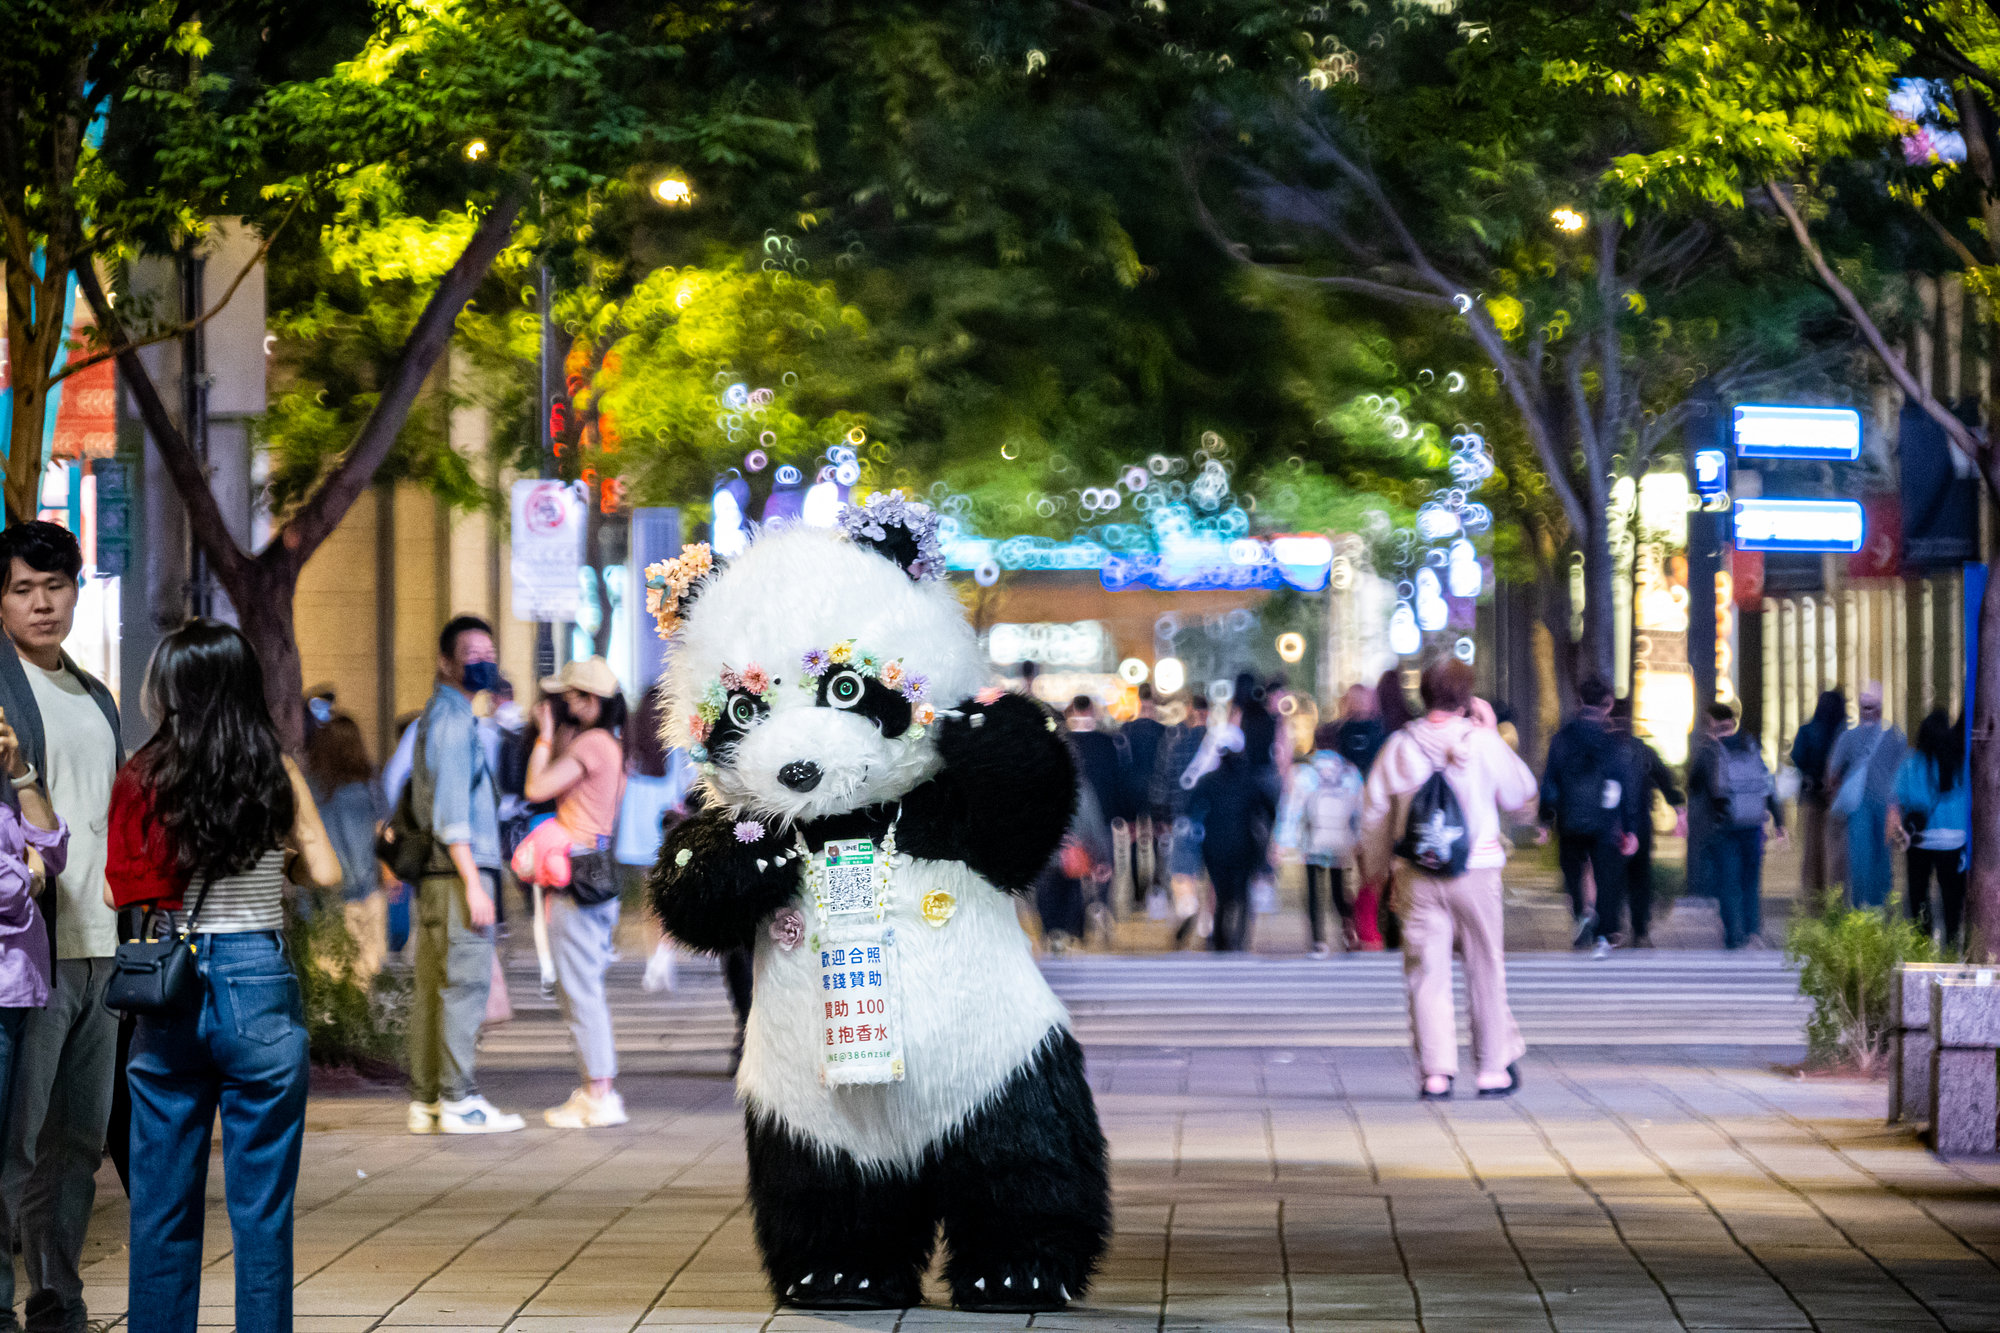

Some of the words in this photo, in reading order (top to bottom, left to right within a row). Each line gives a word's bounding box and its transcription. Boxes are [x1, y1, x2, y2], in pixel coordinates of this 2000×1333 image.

[821, 947, 881, 968] 歡迎合照
[822, 970, 882, 990] 零錢贊助
[825, 1000, 849, 1019] 贊助
[856, 999, 885, 1014] 100
[825, 1023, 888, 1045] 送抱香水
